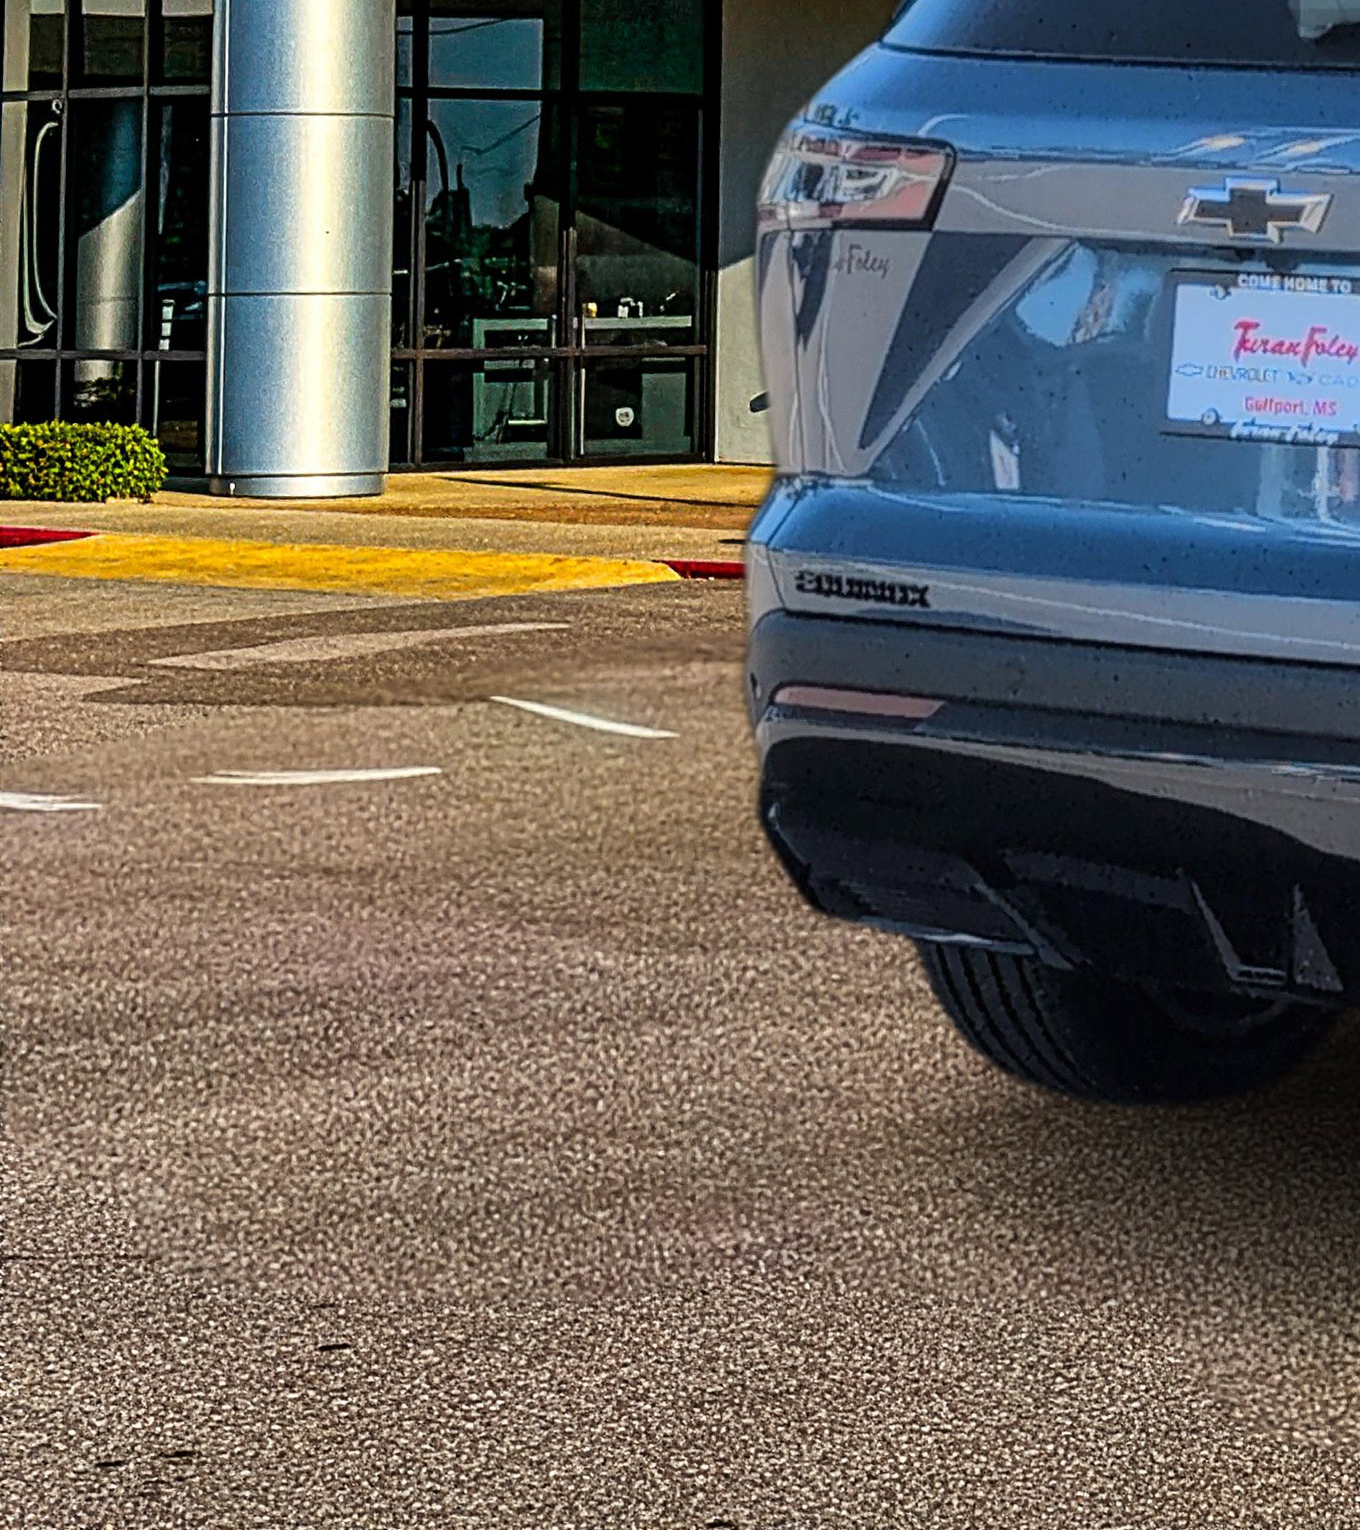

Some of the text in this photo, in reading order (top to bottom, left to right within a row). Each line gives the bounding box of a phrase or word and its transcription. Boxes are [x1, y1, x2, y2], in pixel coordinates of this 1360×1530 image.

[1237, 273, 1352, 294] COME HOME TO
[1313, 400, 1337, 417] MS
